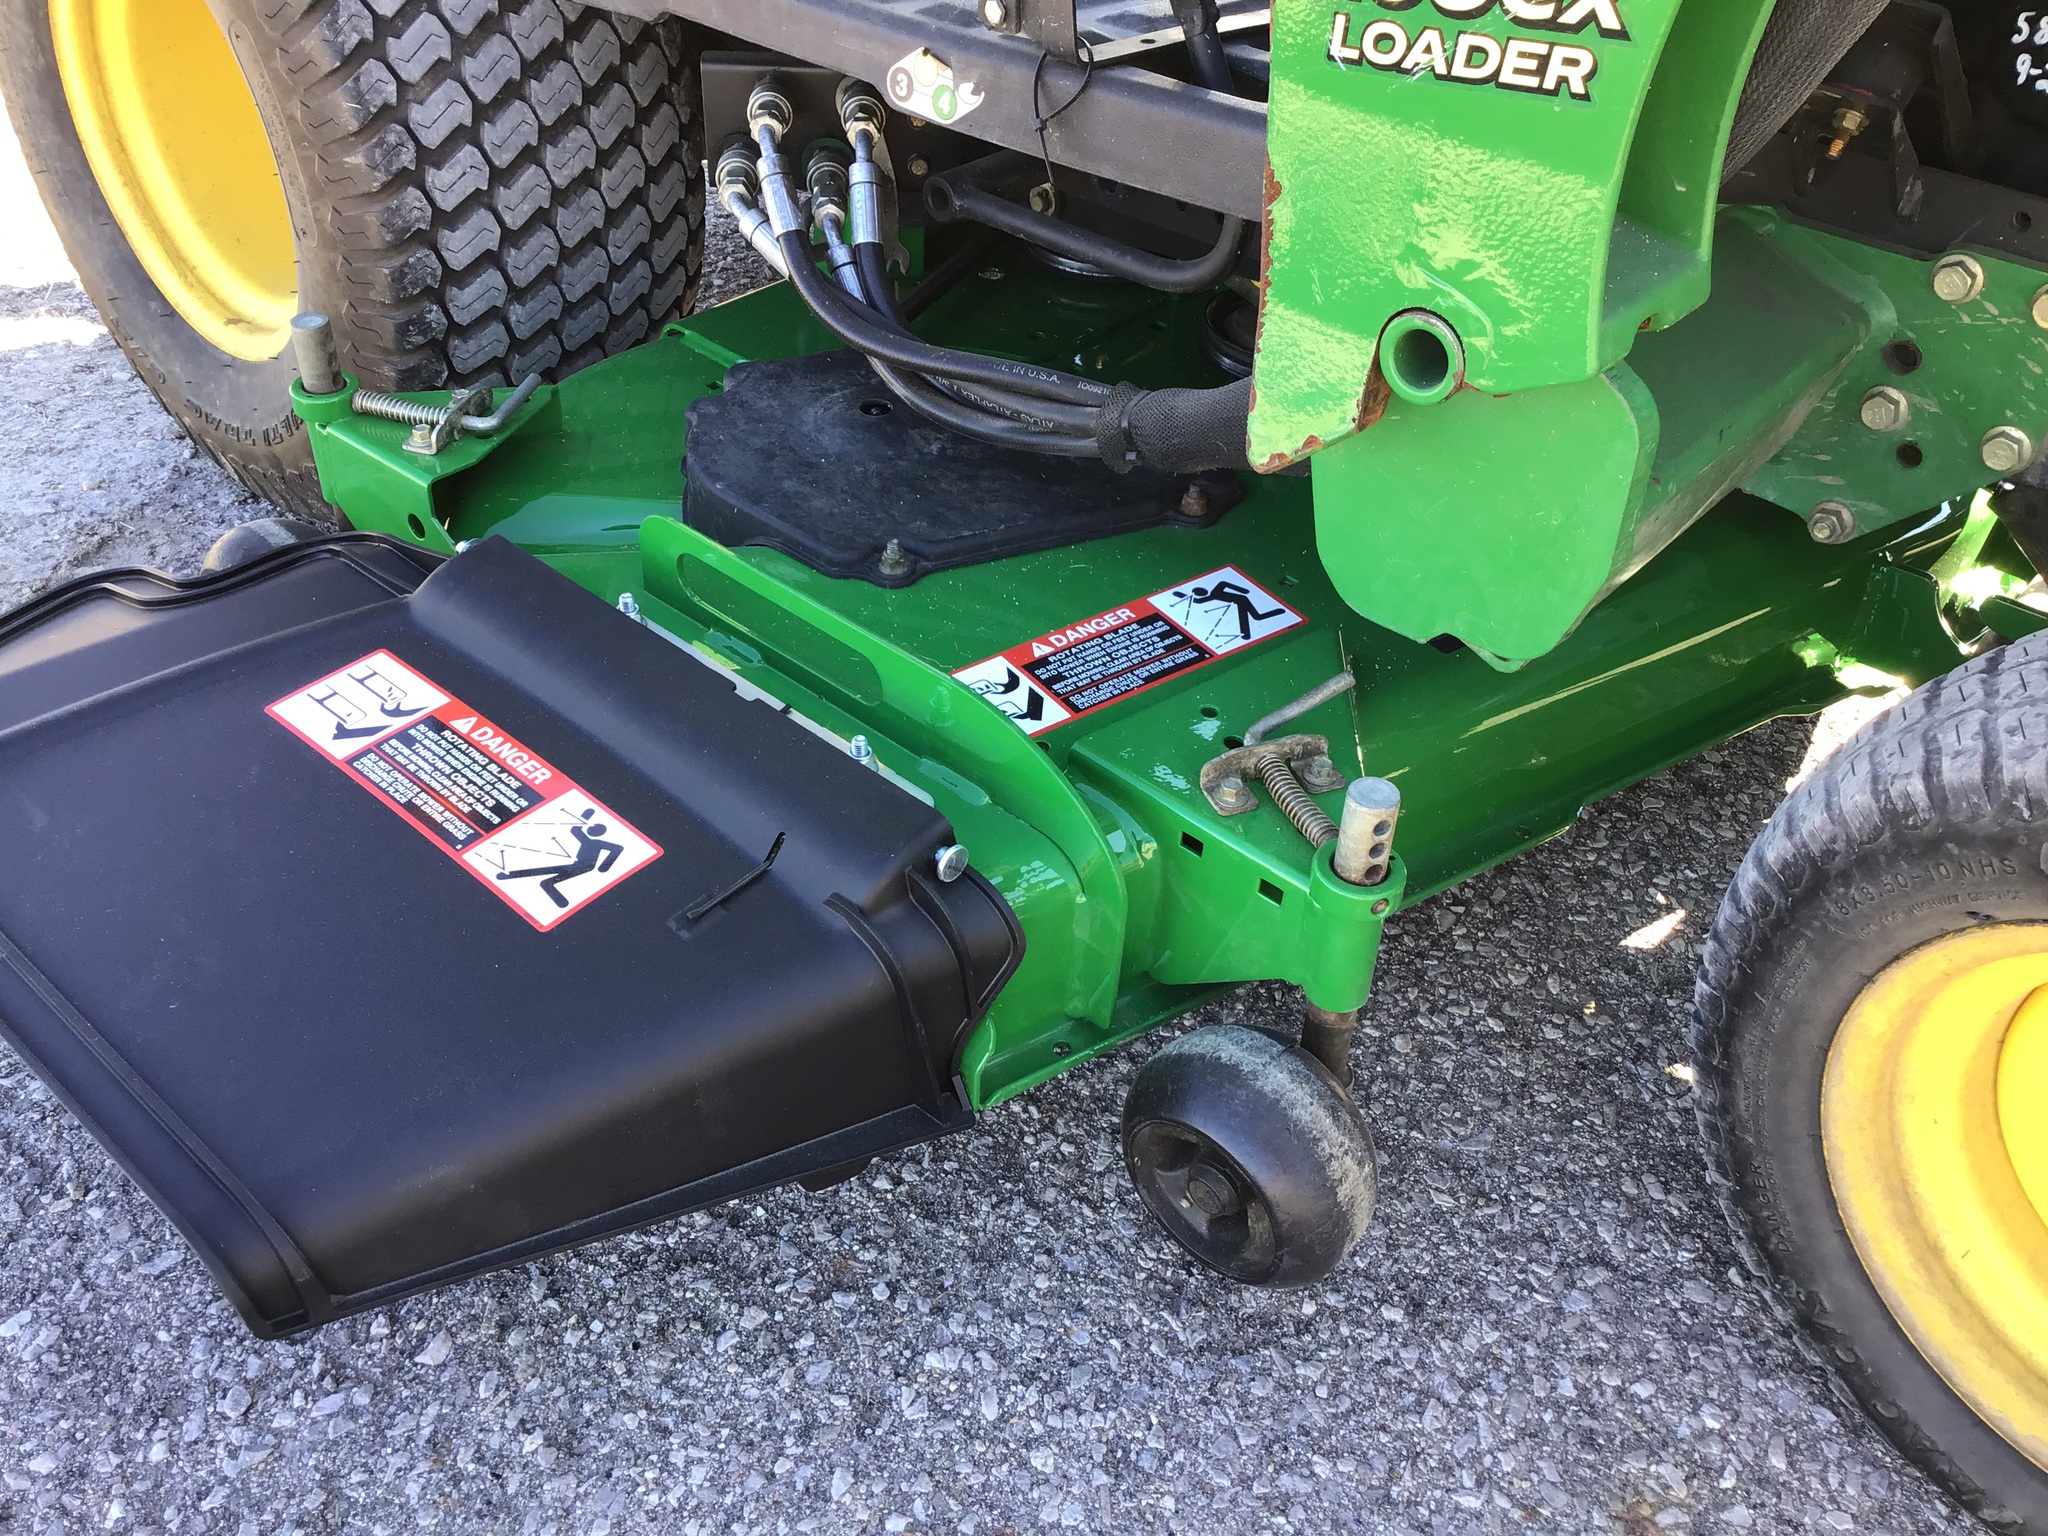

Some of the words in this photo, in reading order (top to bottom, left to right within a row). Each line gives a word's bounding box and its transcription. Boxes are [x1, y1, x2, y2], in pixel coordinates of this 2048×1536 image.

[1327, 12, 1597, 100] LOADER
[2016, 52, 2048, 86] 9-
[895, 72, 908, 97] 3
[938, 91, 950, 115] 4
[1012, 364, 1026, 375] IN
[1027, 368, 1061, 384] U.S.A.
[1020, 412, 1054, 429] ATLAS
[1033, 667, 1047, 675] DO
[1045, 661, 1063, 670] NOT
[1060, 655, 1078, 664] PUT
[1075, 645, 1102, 658] HANDS
[1111, 634, 1131, 644] FEET
[1128, 624, 1154, 637] UNDER
[1039, 669, 1059, 679] INTO
[1056, 658, 1086, 672] MOWER
[1083, 650, 1107, 661] WHEN
[1104, 639, 1133, 653] ENGINE
[1138, 624, 1170, 639] RUNNING
[1047, 606, 1137, 648] DANGER
[1047, 637, 1104, 662] ROTATING
[1102, 622, 1140, 640] BLADE
[1051, 675, 1080, 690] BEFORE
[1105, 656, 1129, 668] CLEAR
[1126, 649, 1147, 659] AREA
[1152, 634, 1183, 648] OBJECTS
[1056, 683, 1078, 694] THAT
[1075, 677, 1093, 686] MAY
[1101, 660, 1134, 676] THROWN
[1141, 647, 1166, 660] BLADE
[1061, 655, 1112, 678] THROWN
[1109, 635, 1161, 658] OBJECTS
[1068, 693, 1082, 701] DO
[1080, 686, 1099, 696] NOT
[1097, 672, 1133, 689] OPERATE
[1132, 660, 1162, 675] MOWER
[1160, 647, 1194, 663] WITHOUT
[1072, 685, 1116, 705] DISCHARGE
[1113, 675, 1140, 688] CHUTE
[1149, 660, 1176, 673] ENTIRE
[1173, 651, 1199, 663] GRASS
[1077, 692, 1113, 709] CATCHER
[1119, 679, 1145, 691] PLACE
[351, 760, 382, 783] CATCHER
[384, 786, 408, 804] PLACE
[379, 743, 399, 756] THAT
[393, 754, 410, 765] MAY
[405, 763, 419, 772] BE
[413, 769, 444, 791] THROWN
[438, 788, 452, 797] BY
[446, 795, 472, 813] BLADE
[387, 738, 413, 756] BEFORE
[429, 770, 453, 787] CLEAR
[446, 783, 468, 798] AREA
[462, 795, 477, 805] OF
[470, 801, 502, 824] OBJECTS
[407, 728, 425, 740] INTO
[420, 738, 447, 757] MOWER
[441, 754, 464, 770] WHEN
[459, 767, 486, 786] ENGINE
[487, 789, 521, 812] RUNNING
[409, 742, 454, 775] THROWN
[448, 772, 497, 807] OBJECTS
[415, 723, 429, 733] DO
[423, 730, 442, 742] NOT
[436, 739, 454, 751] PUT
[447, 748, 473, 765] HANDS
[468, 763, 483, 772] OR
[477, 770, 498, 784] FEET
[492, 781, 519, 800] UNDER
[514, 797, 529, 807] OR
[439, 729, 490, 765] ROTATING
[484, 763, 522, 789] BLADE
[468, 725, 555, 785] DANGER
[358, 756, 395, 783] DISCHARGE
[390, 781, 415, 799] CHUTE
[410, 796, 424, 806] OR
[419, 804, 446, 823] ENTIRE
[440, 820, 467, 840] GRASS
[366, 752, 380, 762] DO
[375, 759, 393, 772] NOT
[388, 769, 421, 794] OPERATE
[416, 791, 445, 812] MOWER
[440, 810, 475, 836] WITHOUT
[1958, 857, 2018, 877] NHS
[1749, 1162, 1793, 1253] DANGER
